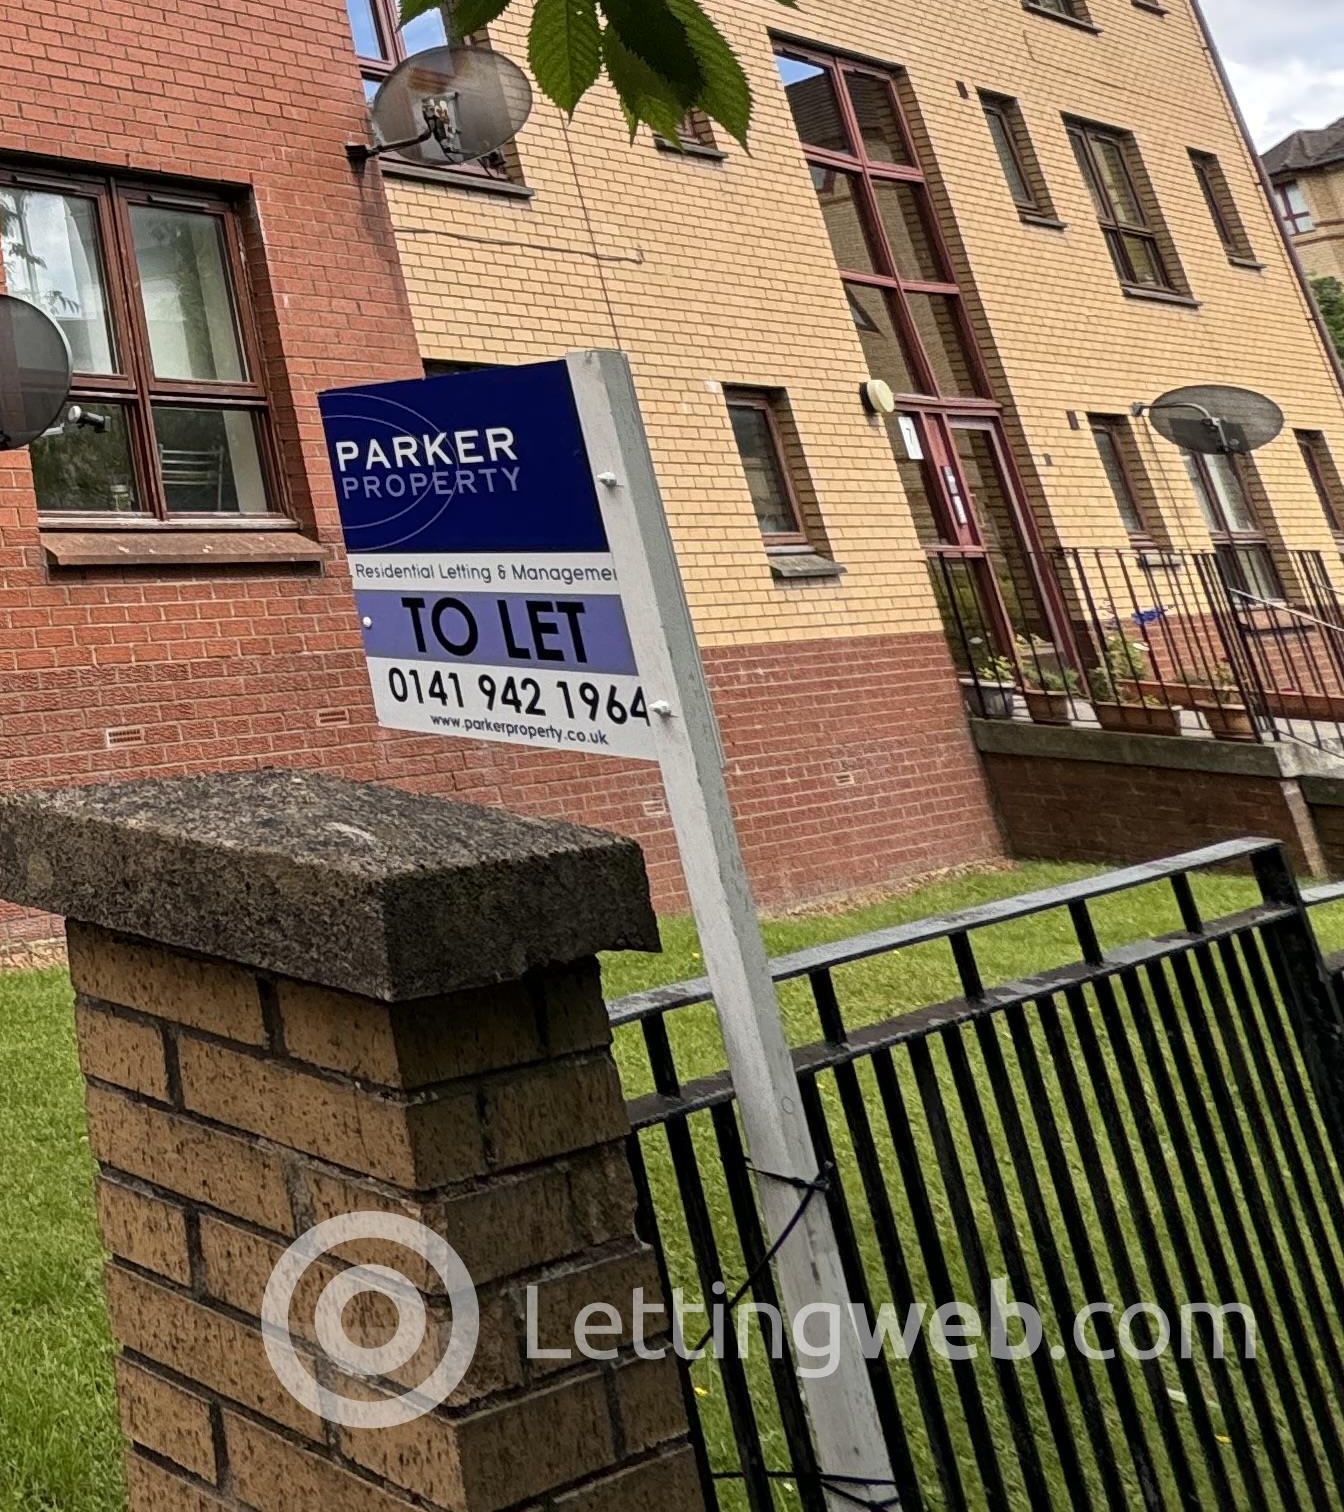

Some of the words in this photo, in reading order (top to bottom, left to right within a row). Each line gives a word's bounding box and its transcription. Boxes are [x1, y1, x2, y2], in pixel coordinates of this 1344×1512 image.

[335, 427, 518, 472] PARKER
[341, 466, 520, 499] PROPERTY
[355, 563, 435, 579] Residential
[439, 564, 492, 584] Letting
[497, 564, 506, 580] &
[401, 597, 479, 657] TO
[497, 599, 588, 663] LET
[388, 667, 464, 708] 0141
[478, 674, 546, 717] 942
[556, 680, 651, 727] 1964
[430, 713, 610, 746] www.parkerproperty.co.uk
